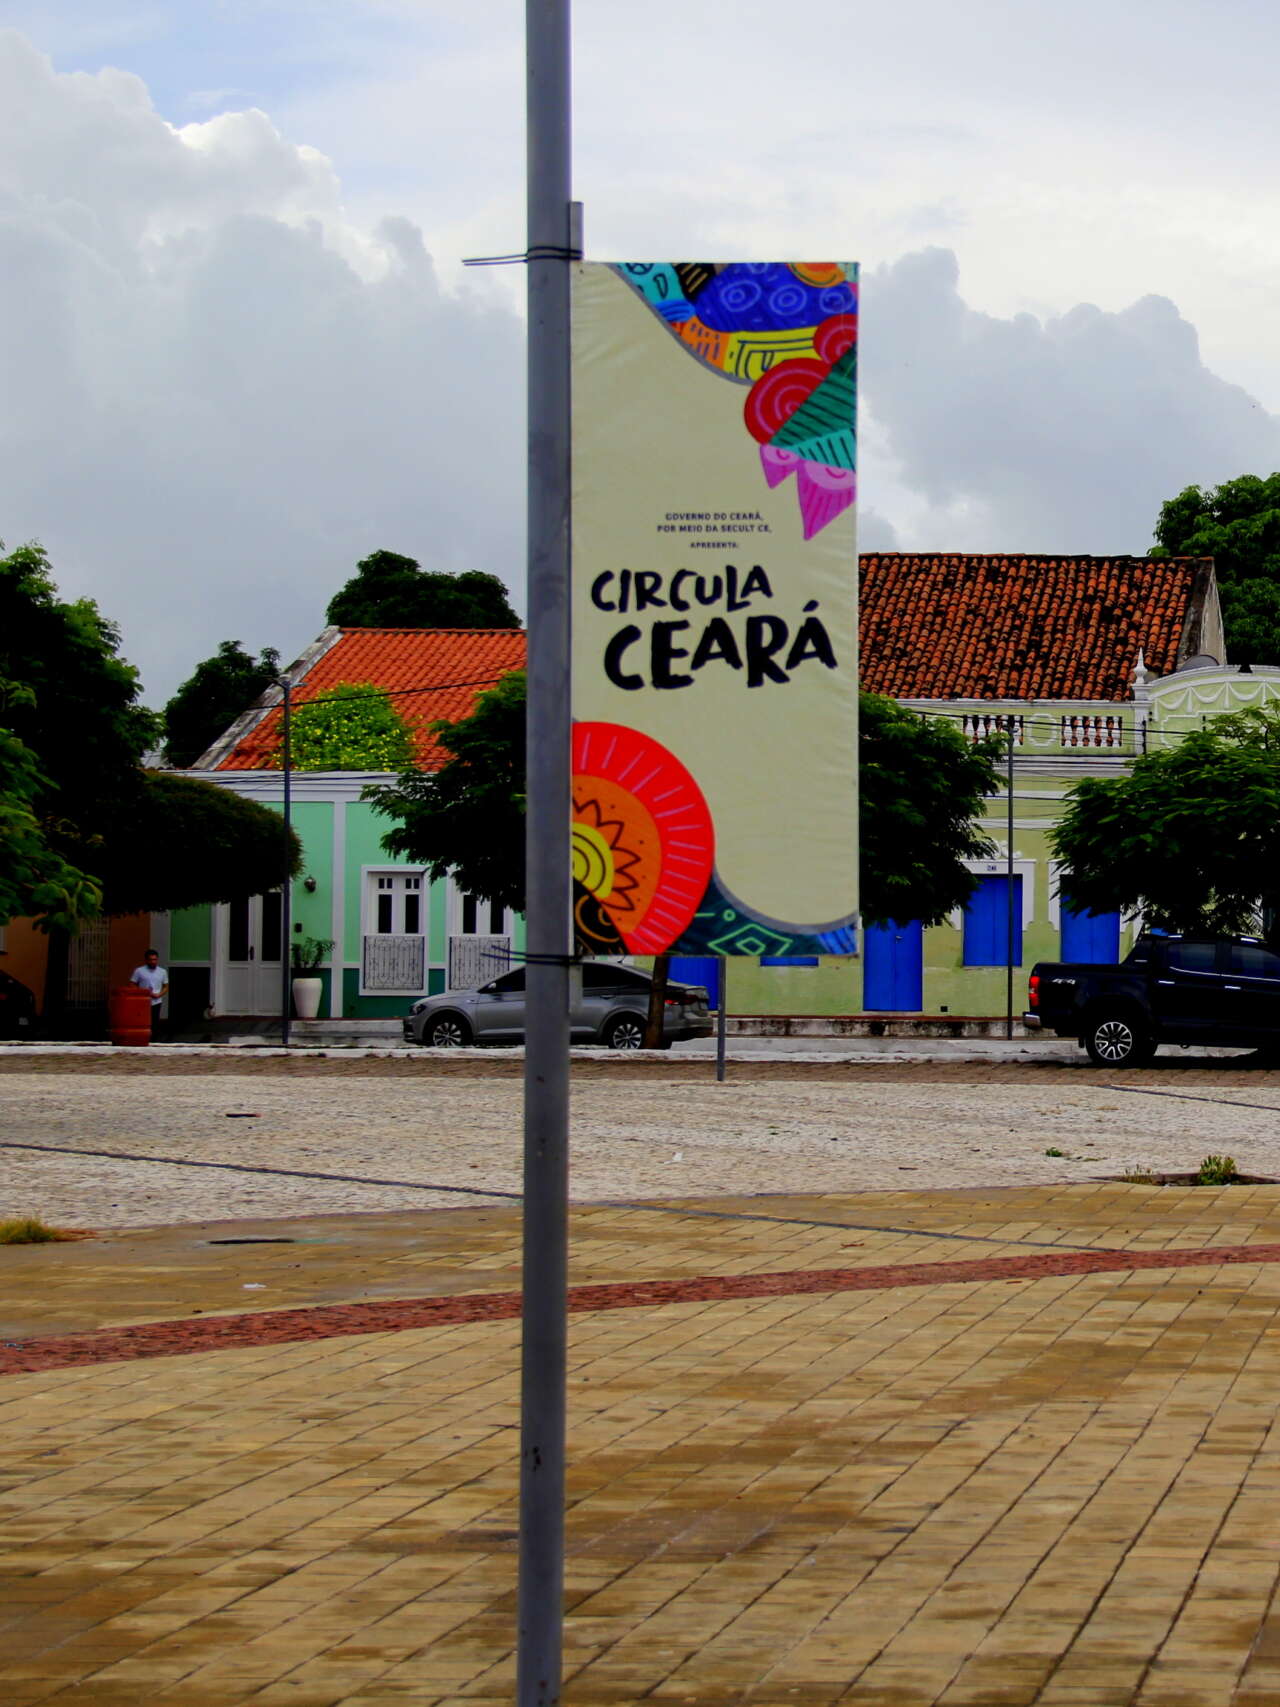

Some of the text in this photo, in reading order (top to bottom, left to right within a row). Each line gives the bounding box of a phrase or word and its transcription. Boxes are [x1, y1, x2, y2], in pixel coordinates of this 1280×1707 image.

[665, 512, 711, 520] GOVERNO
[713, 512, 727, 520] DO
[591, 565, 773, 613] CIRCULA
[604, 599, 838, 690] CEARÁ
